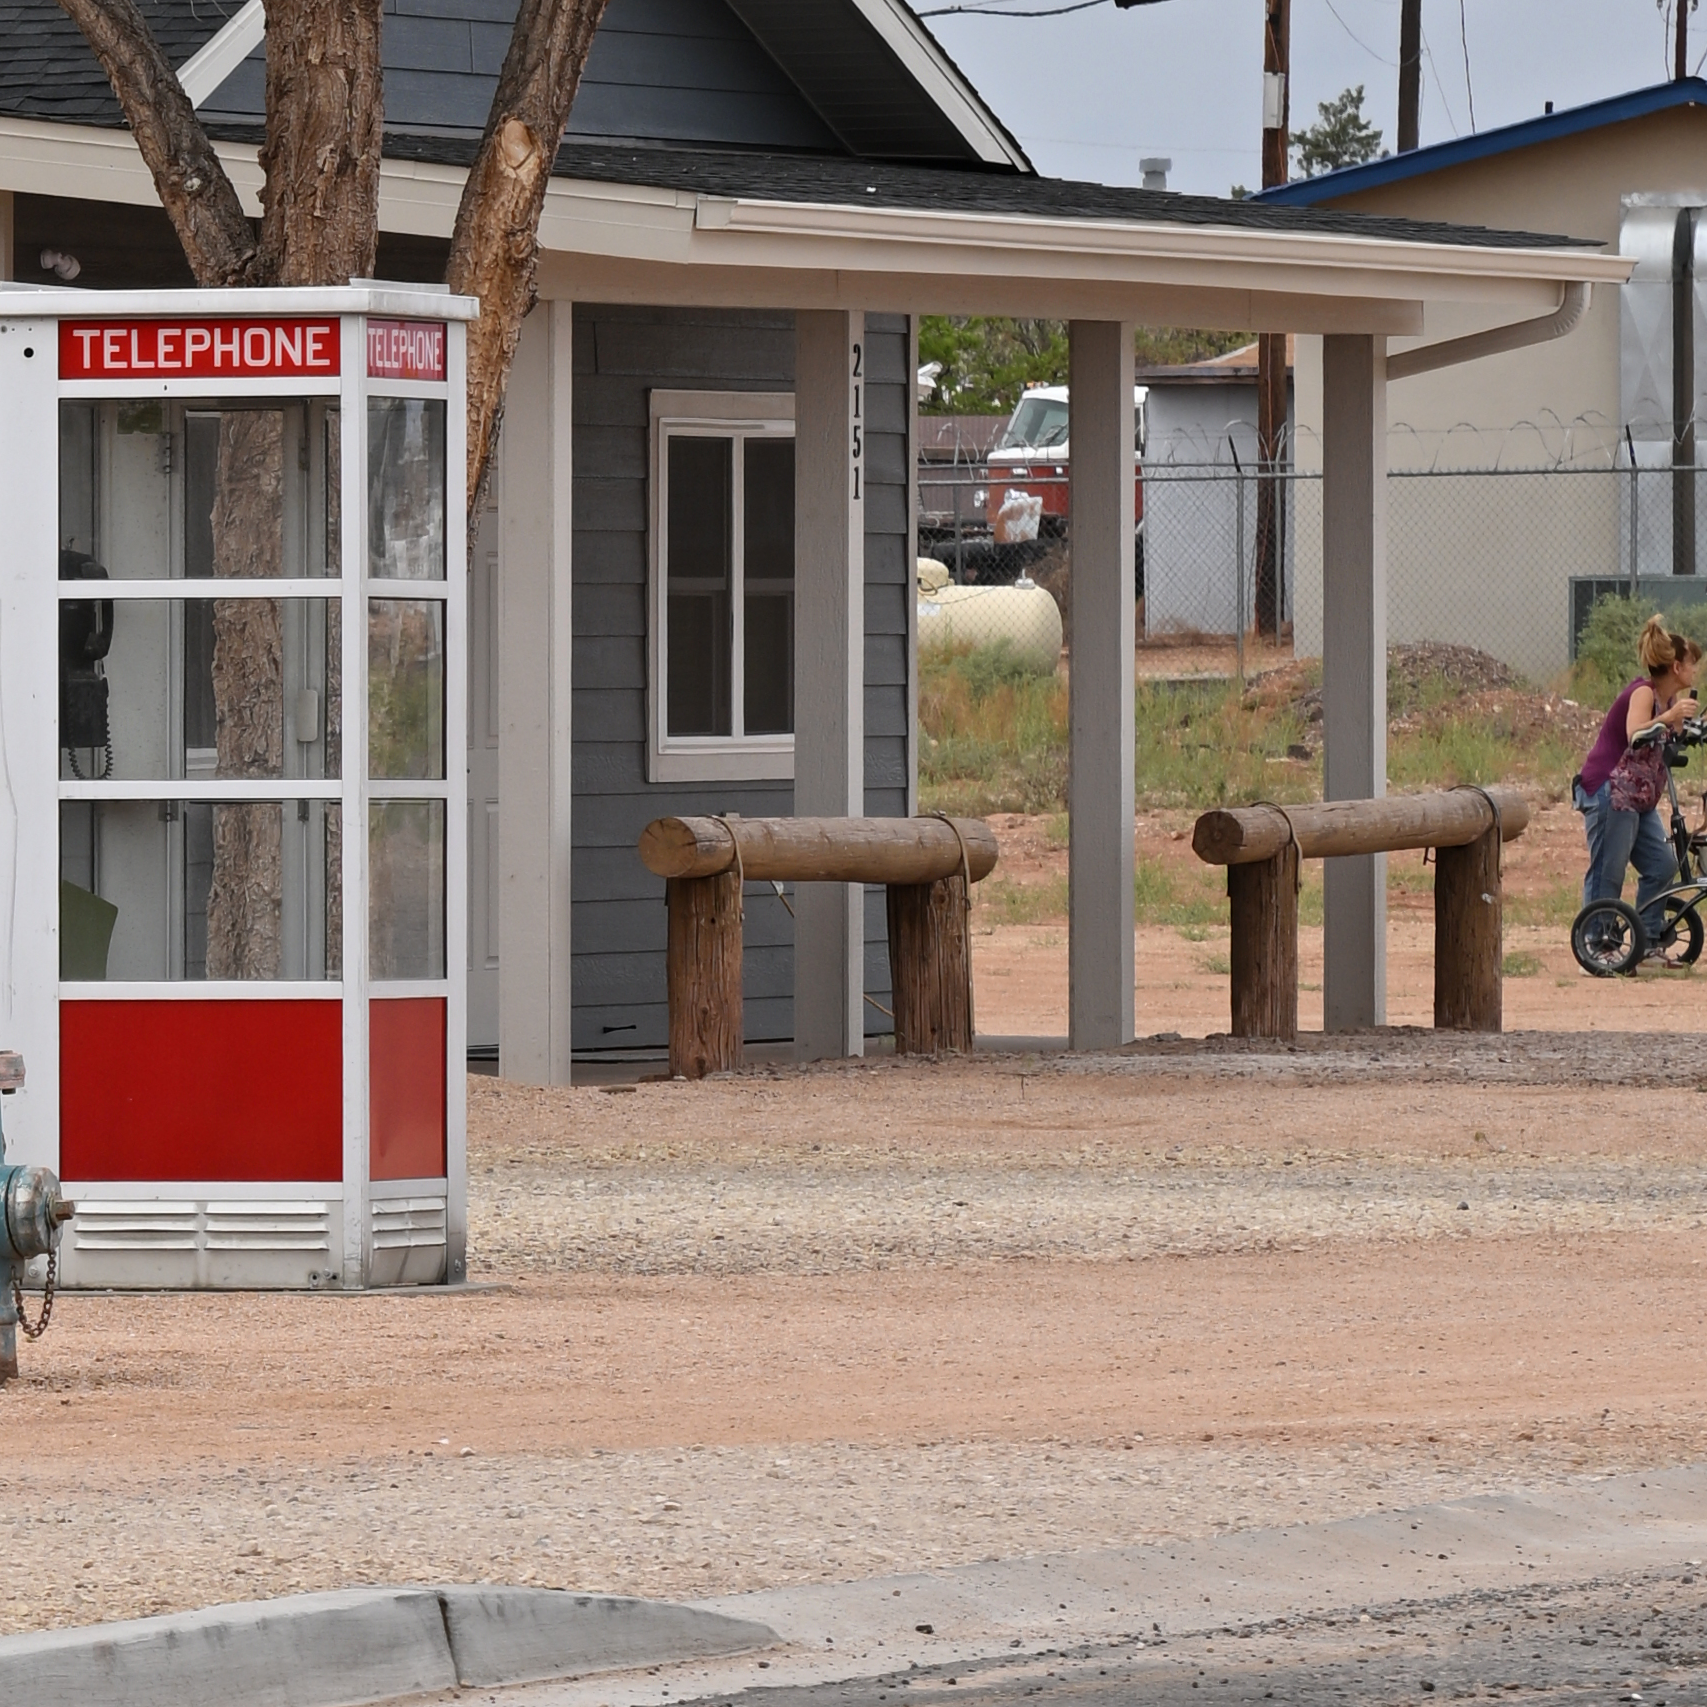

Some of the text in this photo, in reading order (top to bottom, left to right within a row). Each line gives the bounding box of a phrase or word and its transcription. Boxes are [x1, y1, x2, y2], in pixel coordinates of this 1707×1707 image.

[73, 326, 331, 369] TELEPHONE
[367, 328, 442, 371] TELEPHONE
[852, 343, 862, 500] 2151
